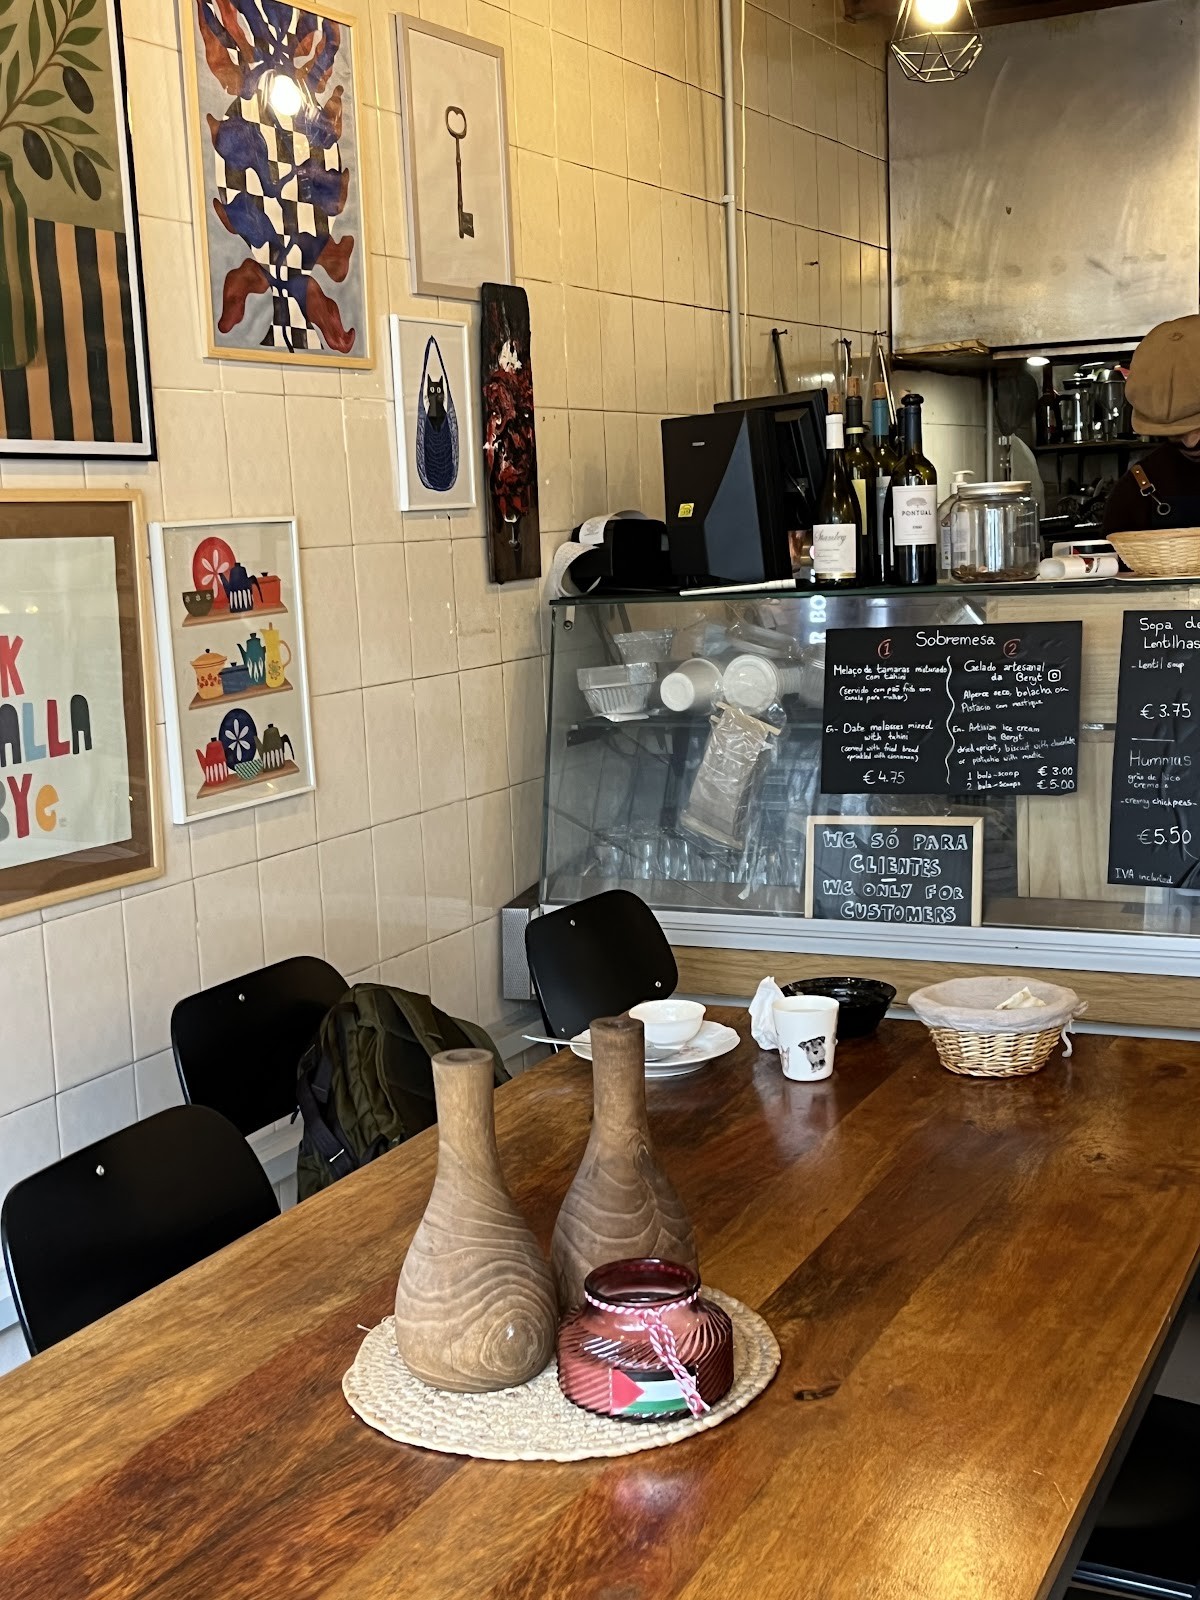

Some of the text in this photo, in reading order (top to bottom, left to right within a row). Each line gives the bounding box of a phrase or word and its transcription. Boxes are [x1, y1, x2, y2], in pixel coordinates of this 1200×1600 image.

[1139, 617, 1173, 637] Sopa
[915, 630, 996, 647] Sobremesa
[1143, 633, 1200, 650] Lentilhas
[833, 664, 862, 677] Melaço
[864, 664, 873, 674] de
[877, 663, 910, 674] tamaras
[964, 660, 1045, 672] Gelado artesanal
[1166, 662, 1185, 674] soup
[865, 673, 880, 681] com
[991, 673, 1003, 681] da
[839, 685, 869, 696] (servido
[887, 685, 900, 694] pão
[1016, 684, 1052, 697] bolacha
[866, 695, 880, 703] para
[1159, 703, 1191, 718] 3.75
[843, 722, 865, 734] Date
[908, 720, 934, 730] mixed
[864, 731, 909, 740] with tahini
[987, 733, 997, 741] by
[866, 743, 880, 751] with
[884, 742, 897, 752] fried
[902, 745, 919, 753] bread
[957, 743, 974, 753] dried
[1005, 742, 1030, 752] biscuit
[1033, 740, 1048, 749] with
[1129, 750, 1192, 767] Hummus
[967, 772, 973, 780] 1
[1052, 766, 1073, 776] 3.00
[1049, 779, 1075, 789] 5.00
[870, 828, 899, 849] SÓ
[913, 834, 968, 851] PARA
[849, 854, 942, 878] CLIENTES
[1114, 867, 1134, 879] IVA
[862, 883, 913, 899] ONLY
[925, 884, 964, 900] FOR
[840, 900, 957, 924] CUSTOMERS
